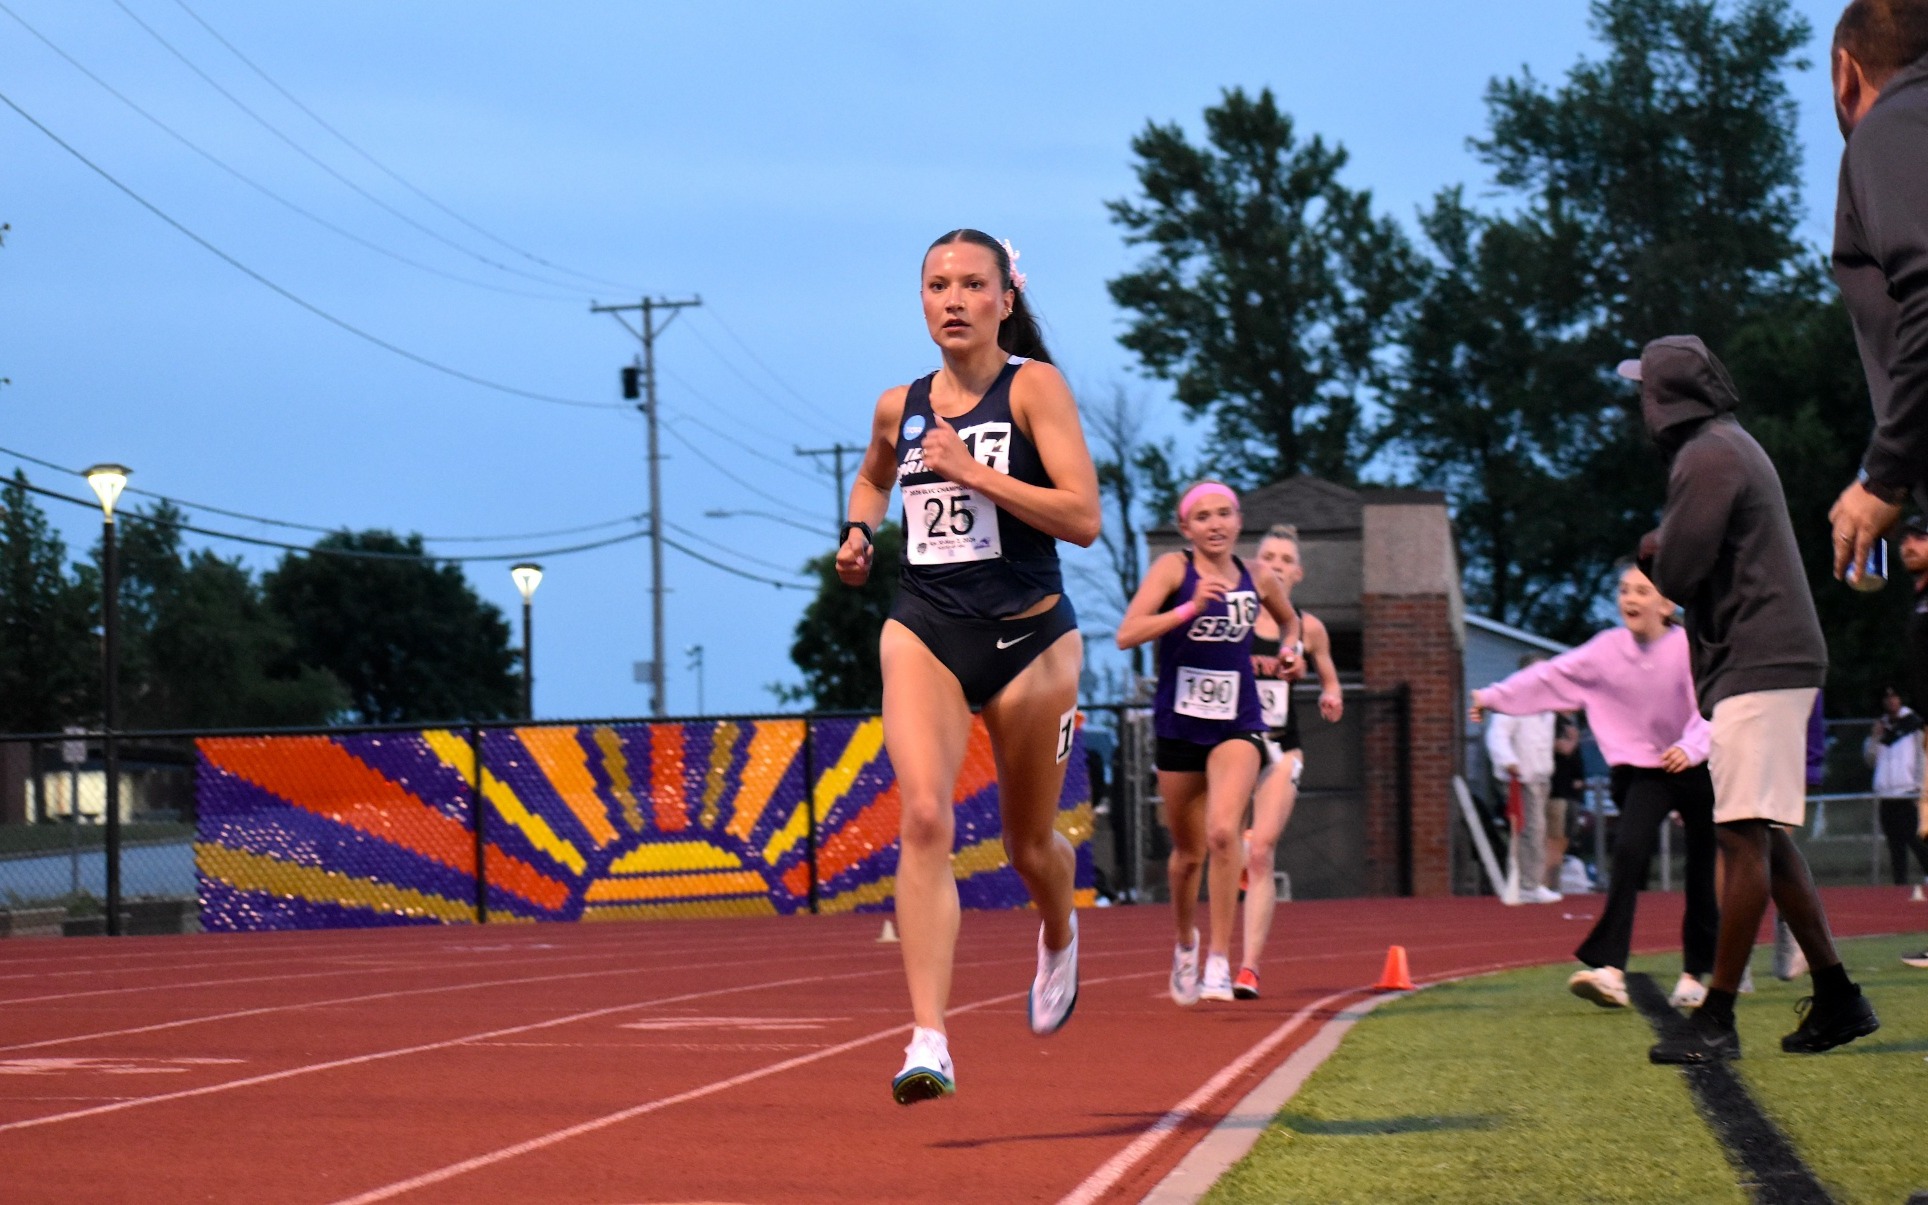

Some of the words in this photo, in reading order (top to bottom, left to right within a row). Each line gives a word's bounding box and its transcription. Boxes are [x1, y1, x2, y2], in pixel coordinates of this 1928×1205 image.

[924, 494, 974, 538] 25
[1227, 596, 1259, 625] 16
[1188, 617, 1247, 641] SBU
[1184, 675, 1233, 704] 190
